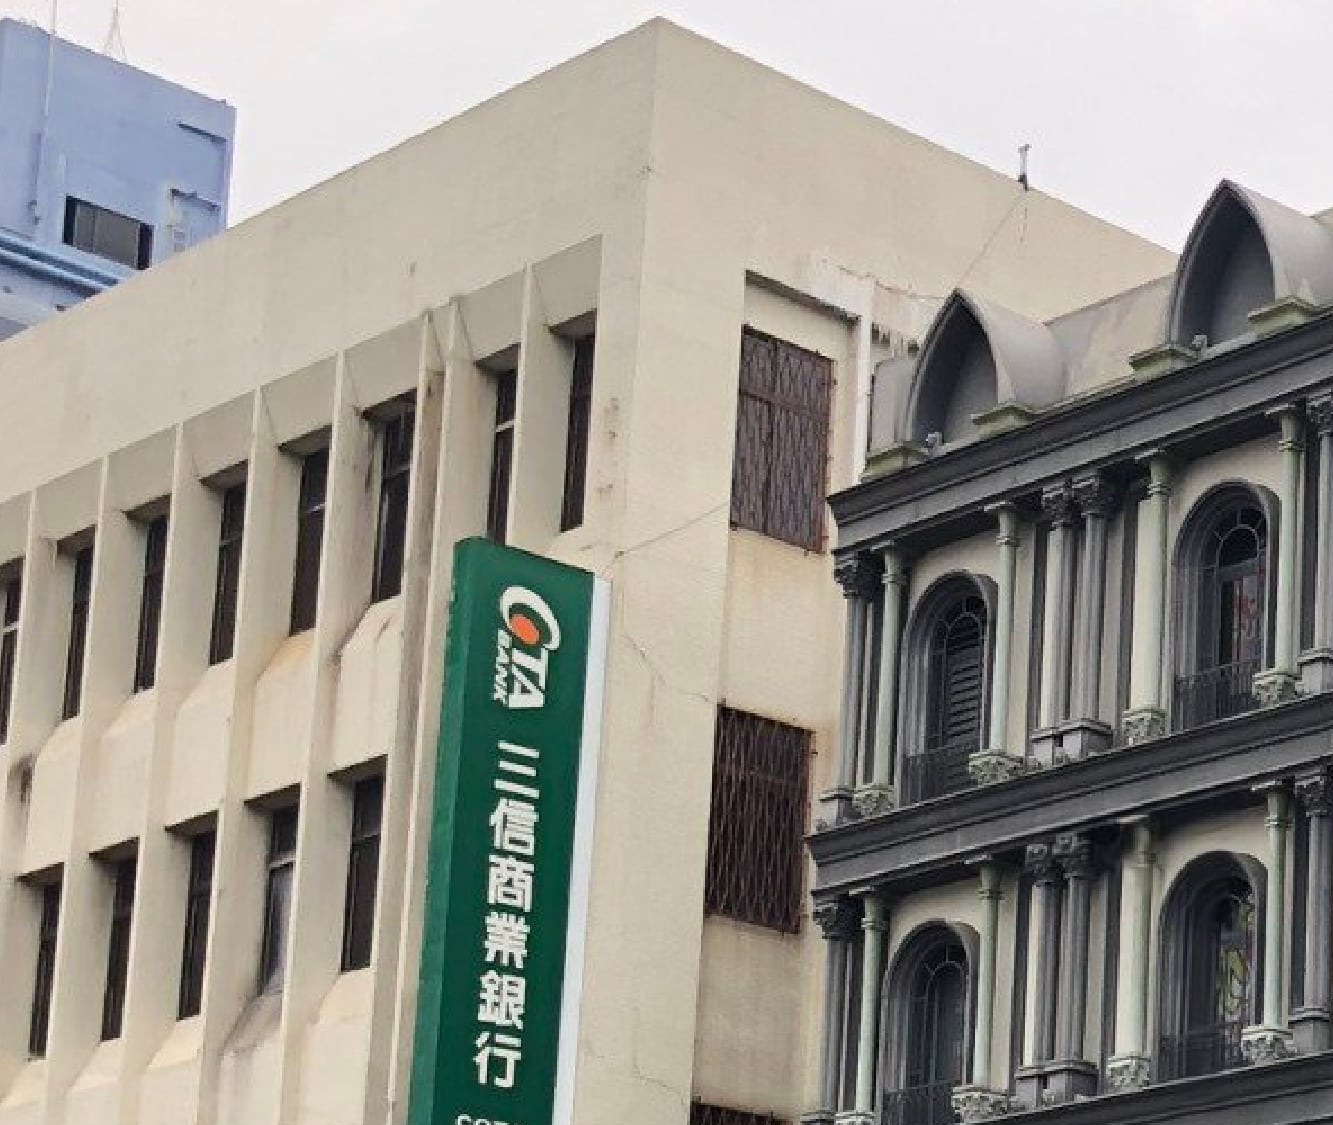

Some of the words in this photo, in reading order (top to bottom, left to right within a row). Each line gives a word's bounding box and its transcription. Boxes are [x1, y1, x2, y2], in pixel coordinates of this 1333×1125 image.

[472, 740, 540, 1088] 三信商業銀行
